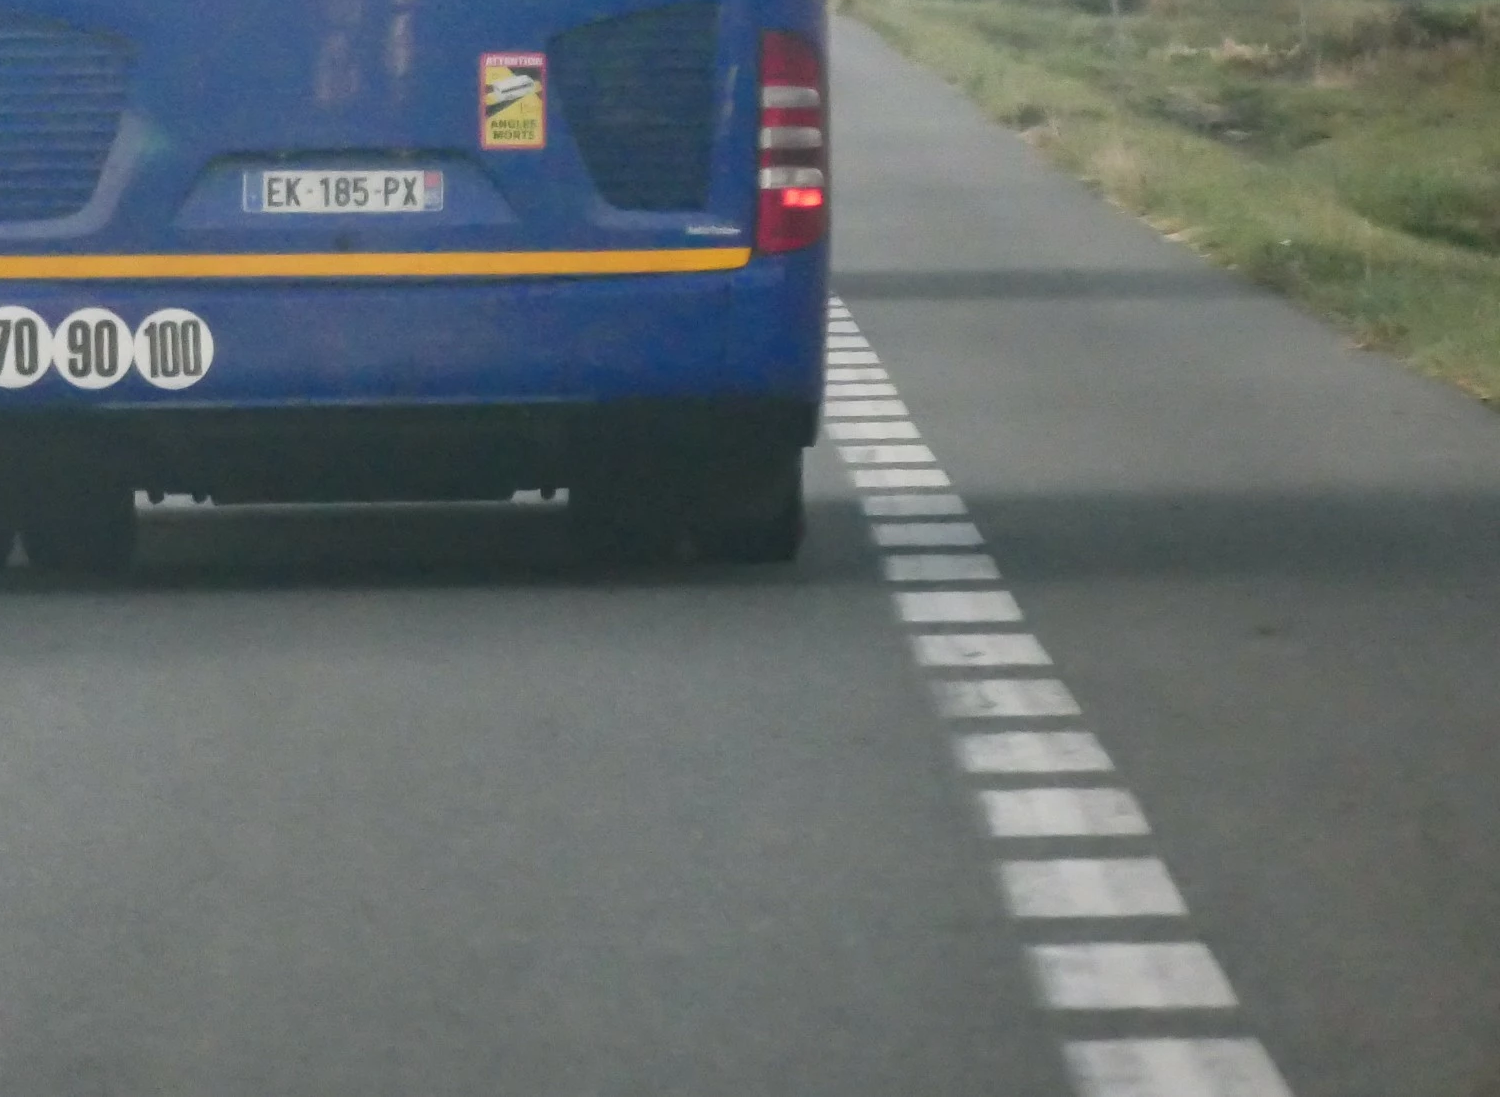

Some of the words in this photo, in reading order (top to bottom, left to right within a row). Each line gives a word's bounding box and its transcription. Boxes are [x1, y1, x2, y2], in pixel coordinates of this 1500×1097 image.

[266, 176, 418, 207] EK-185-PX
[67, 319, 118, 378] 90
[143, 319, 203, 378] 100
